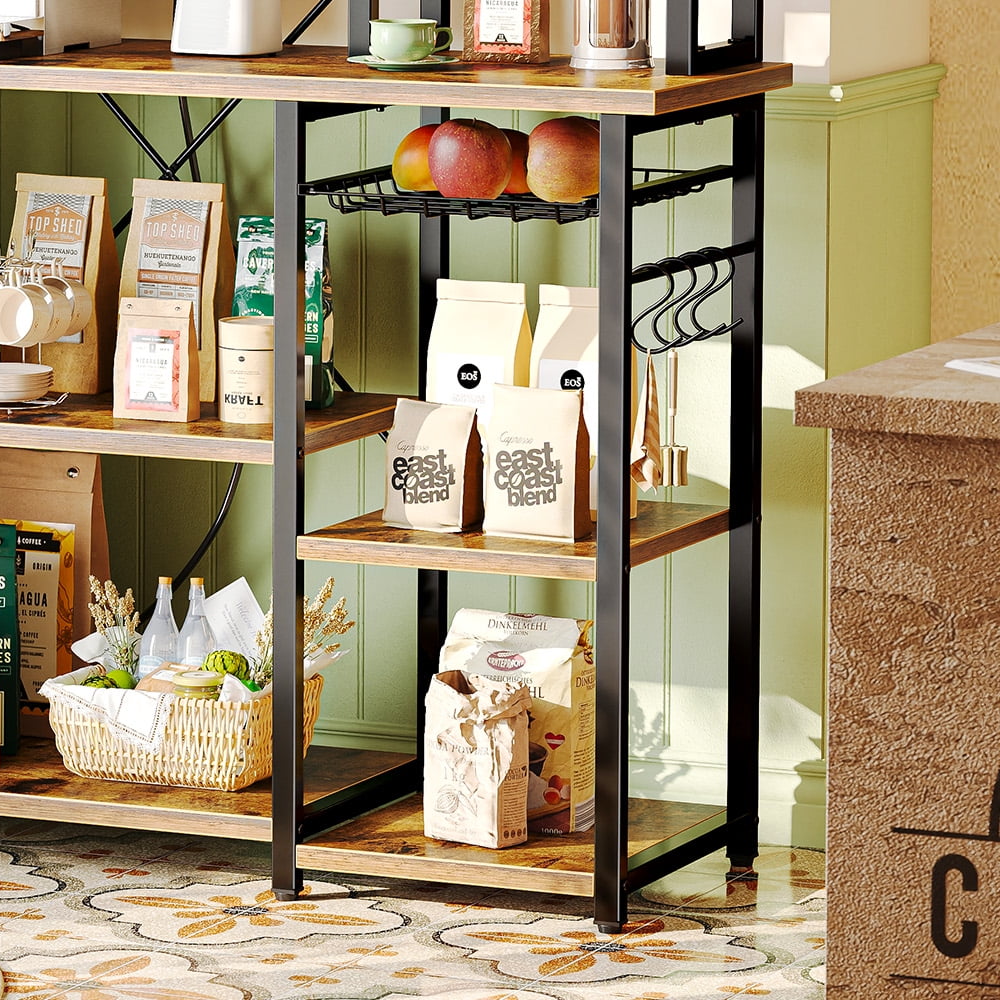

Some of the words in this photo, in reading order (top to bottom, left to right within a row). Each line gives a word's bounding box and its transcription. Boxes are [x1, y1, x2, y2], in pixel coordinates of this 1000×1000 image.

[28, 216, 50, 232] TOP
[52, 218, 83, 236] SHED
[146, 222, 167, 238] TOP
[169, 223, 200, 242] SHED
[144, 252, 197, 262] HUEHUETENANGO
[392, 449, 448, 474] east
[495, 442, 554, 471] east
[391, 464, 456, 491] coast
[494, 459, 563, 491] coast
[402, 484, 450, 505] blend
[507, 483, 557, 507] blend
[21, 537, 42, 546] COFFEE
[32, 562, 52, 571] ORIGIN
[488, 618, 548, 631] DINKELMEHL
